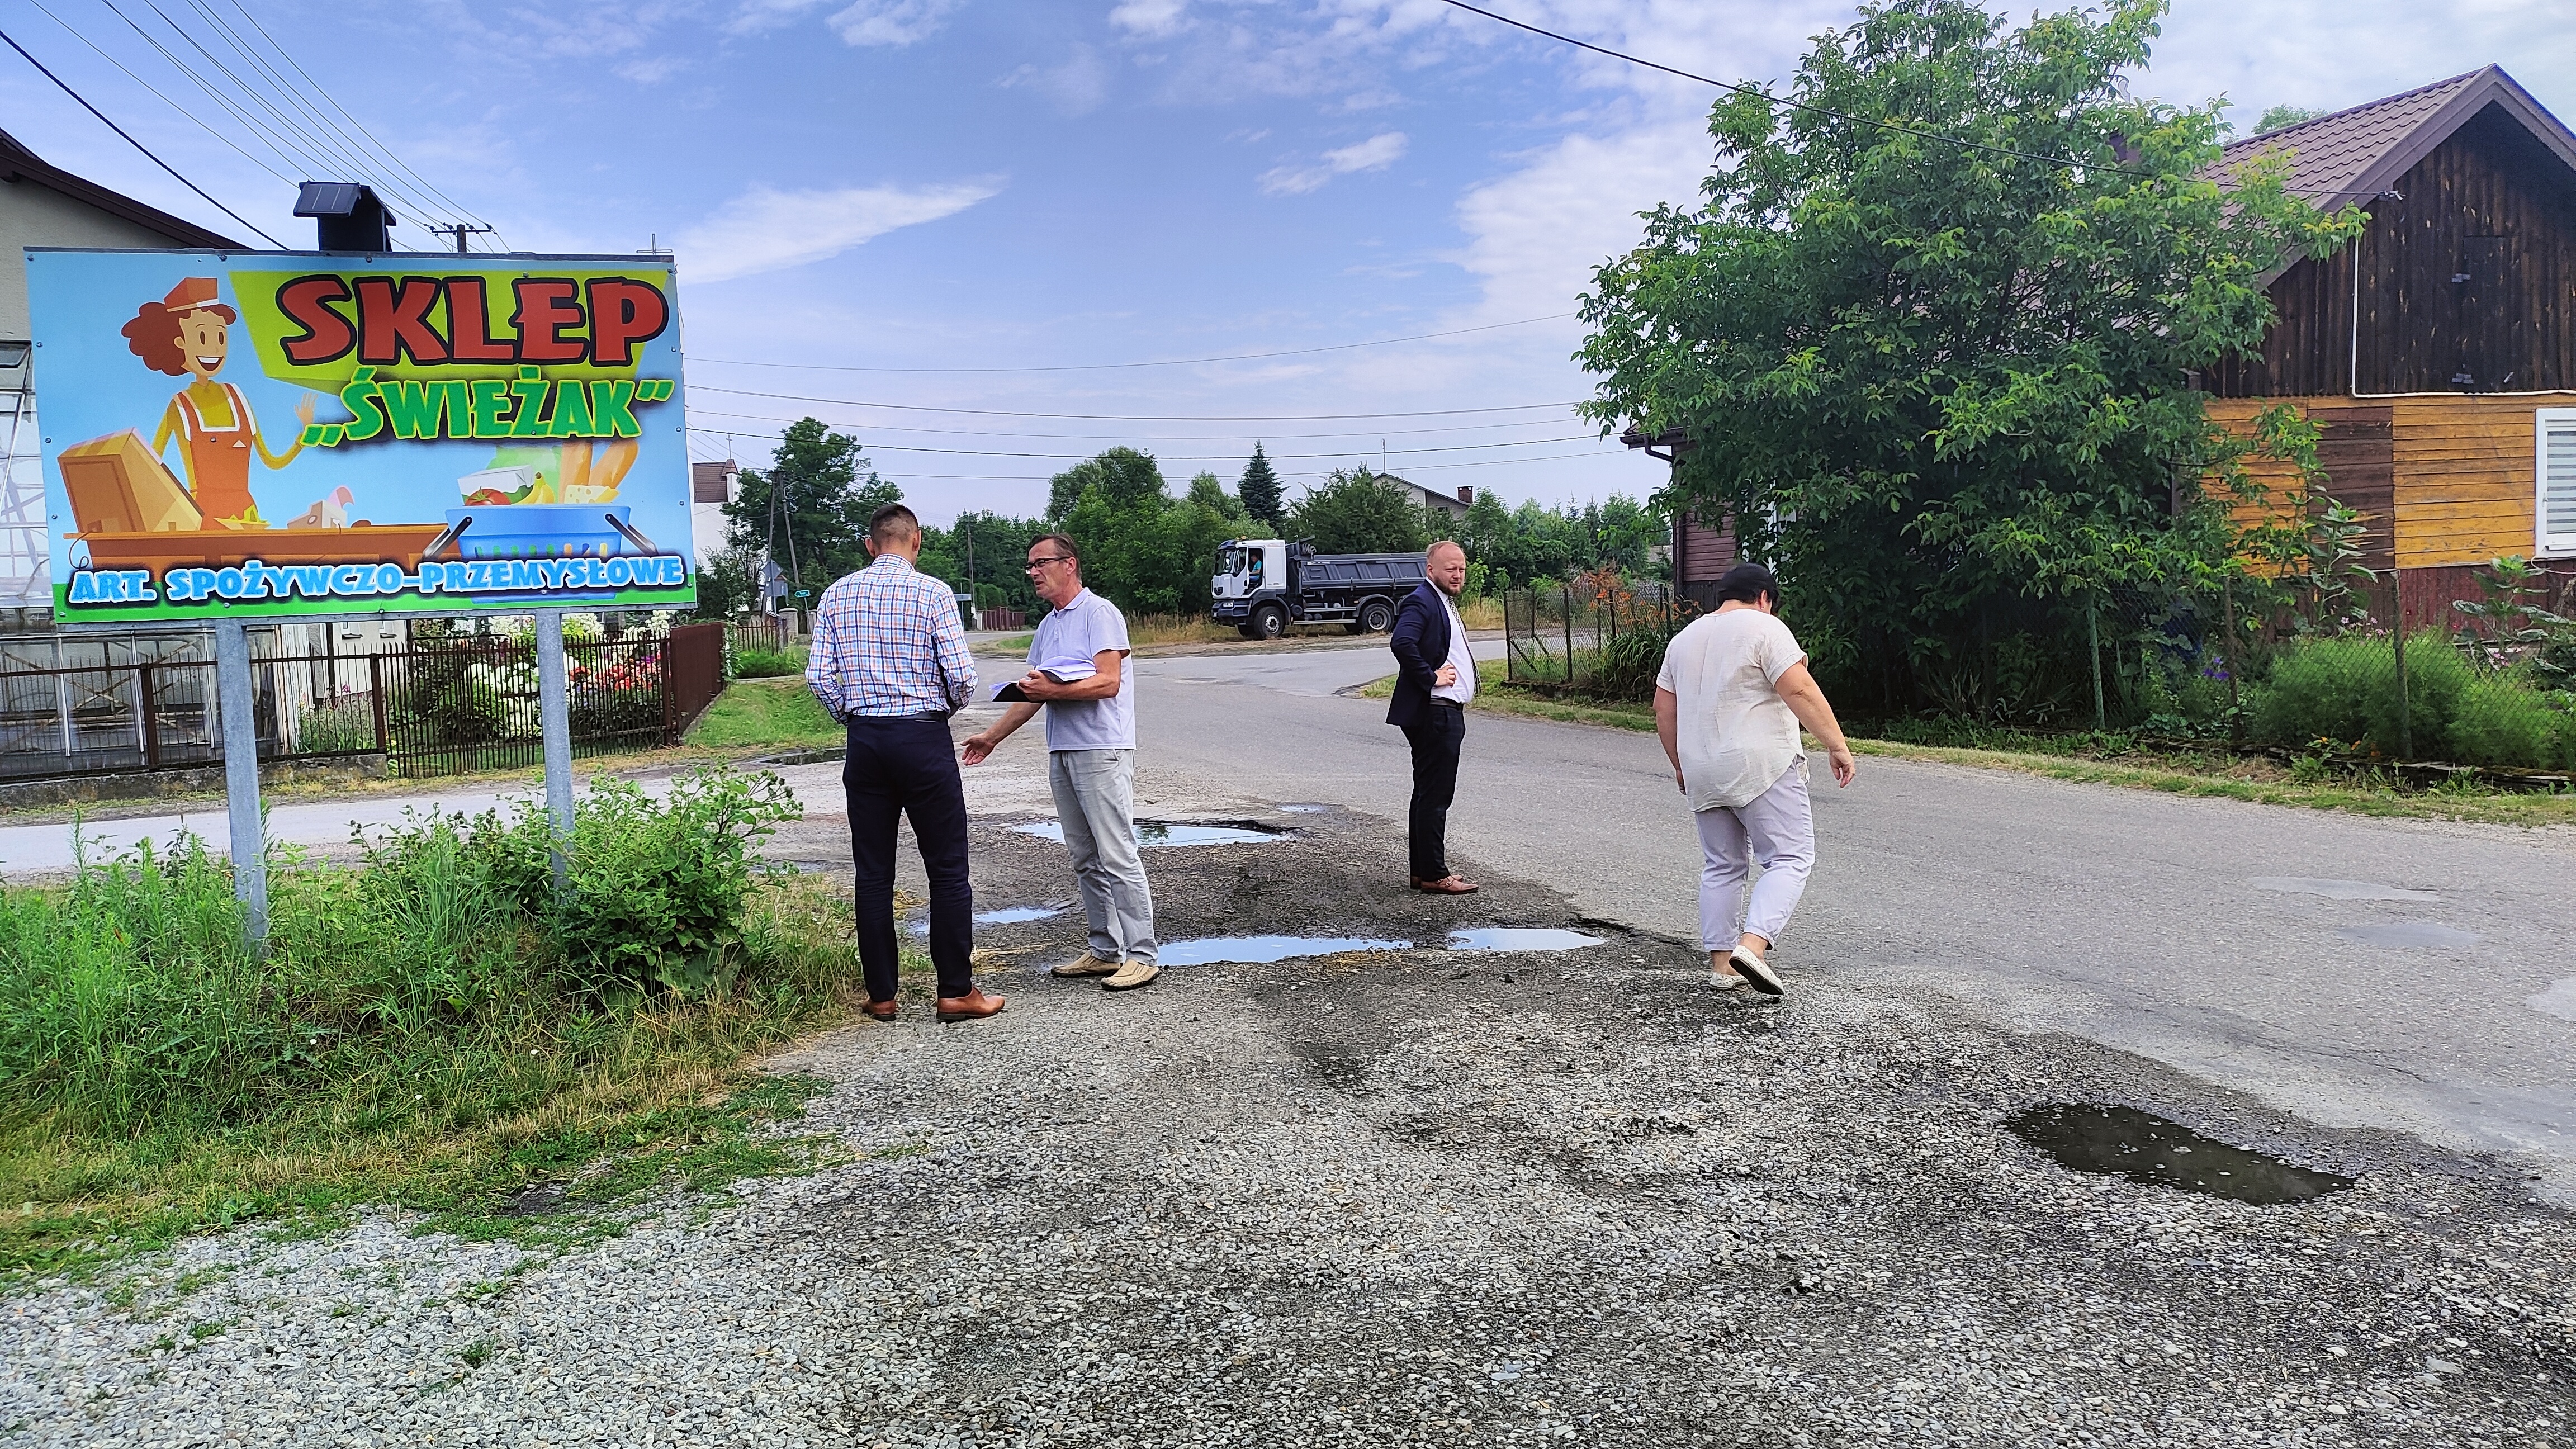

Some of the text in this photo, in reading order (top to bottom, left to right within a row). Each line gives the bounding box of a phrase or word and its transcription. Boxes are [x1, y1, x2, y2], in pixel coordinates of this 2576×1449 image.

[276, 275, 669, 366] SKLEP
[69, 556, 684, 603] ART. SPOŻYWCZO-PRZEMYSŁOWE
